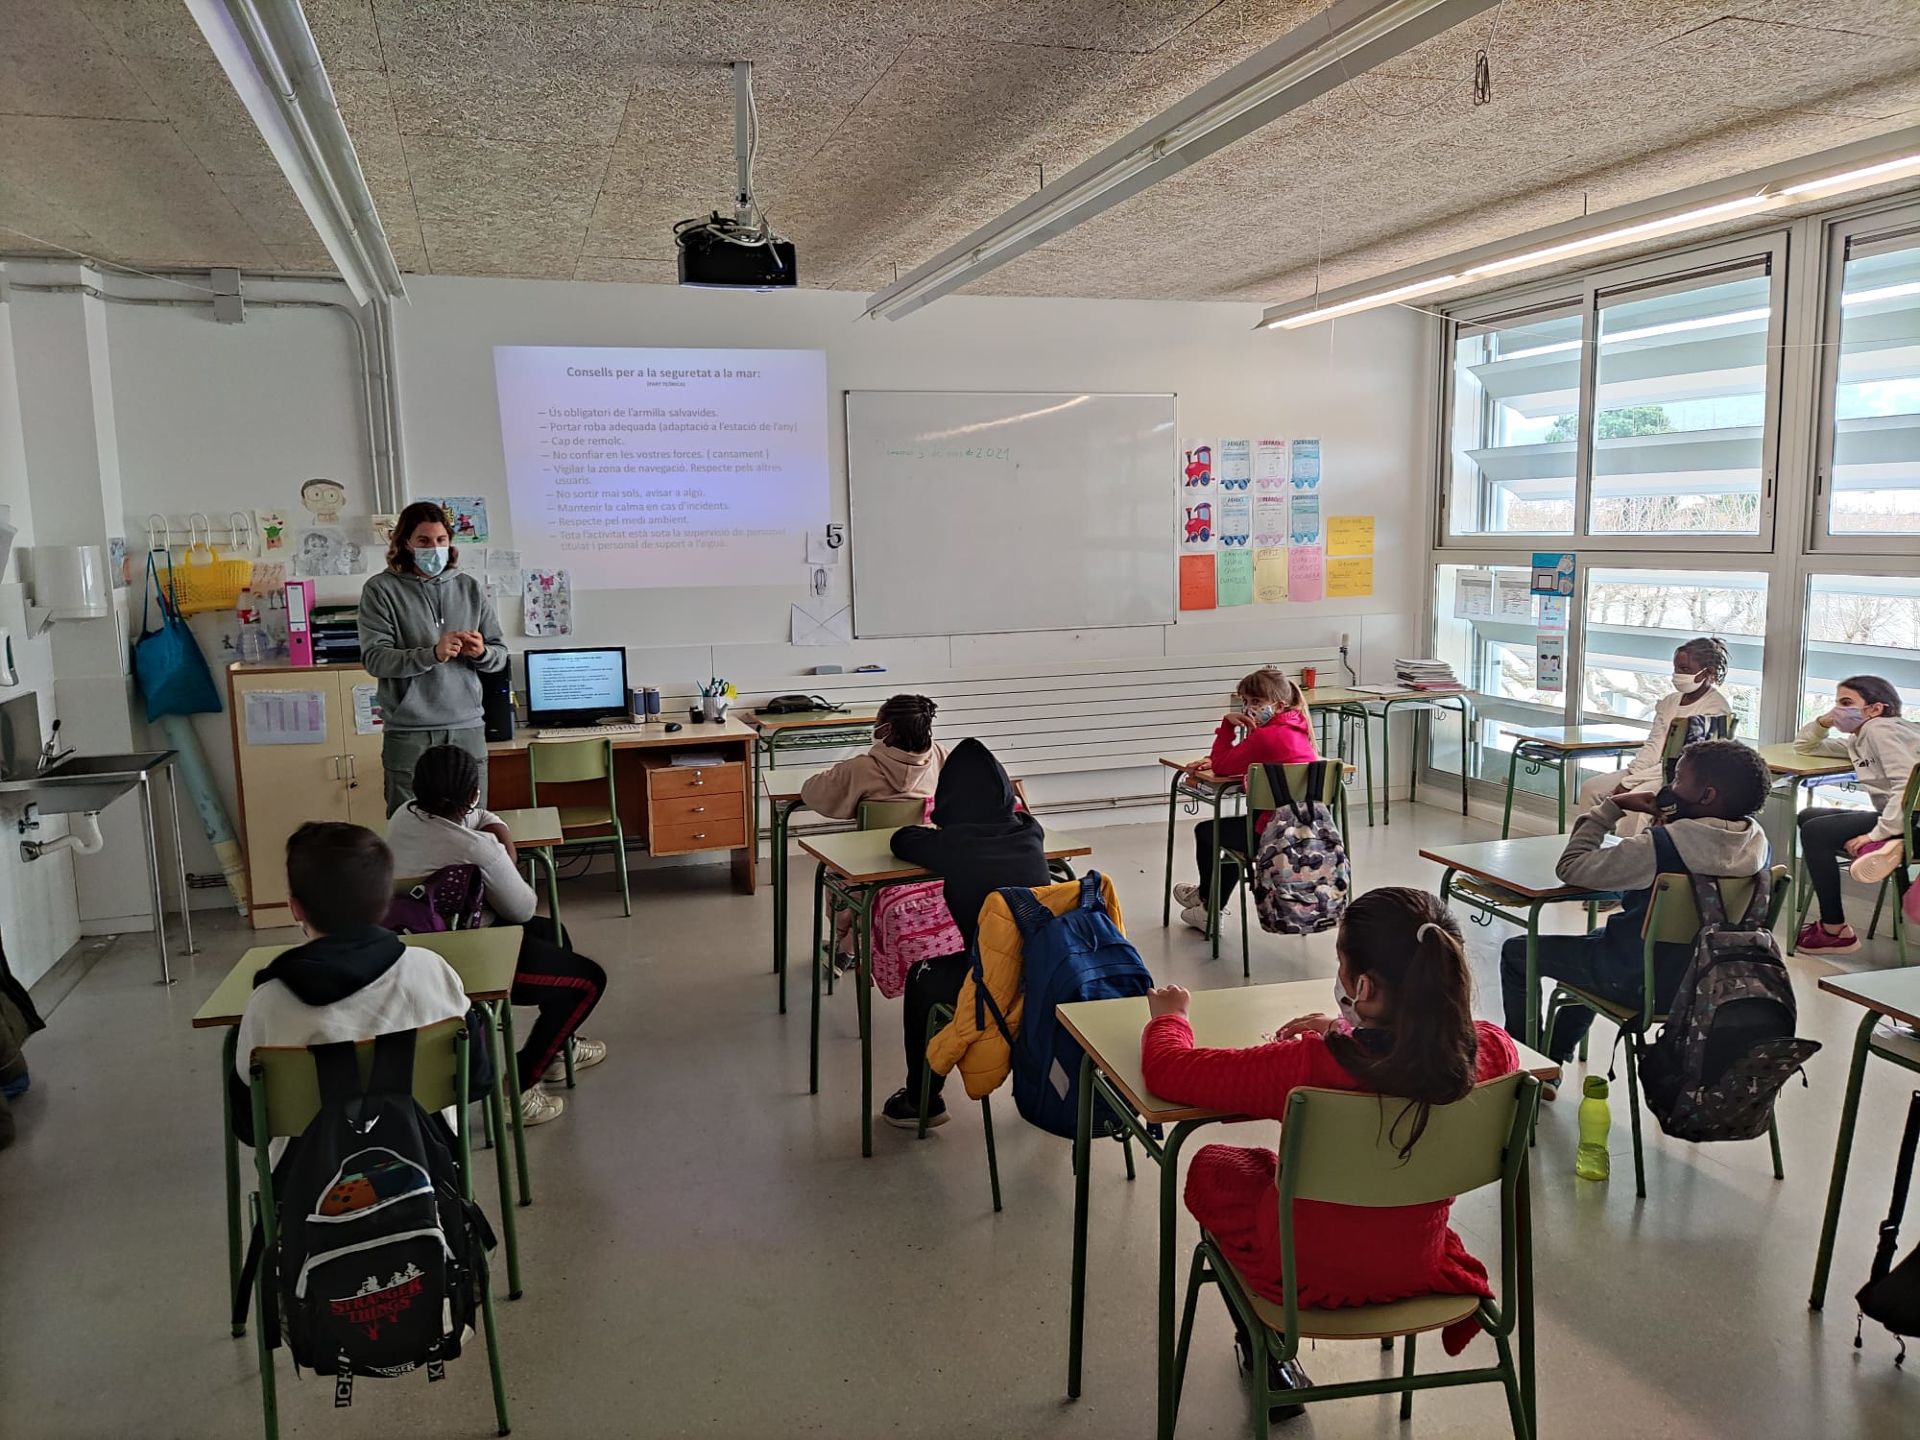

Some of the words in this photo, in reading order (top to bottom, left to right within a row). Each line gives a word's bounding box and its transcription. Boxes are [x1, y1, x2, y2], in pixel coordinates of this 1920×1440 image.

[566, 367, 613, 377] Consells
[616, 370, 634, 380] per
[637, 370, 644, 378] a
[647, 367, 657, 378] la
[660, 368, 712, 380] seguretat
[723, 368, 733, 379] la
[736, 370, 761, 379] mar:
[548, 405, 562, 417] Ús
[564, 407, 610, 419] obligatori
[613, 408, 626, 417] de
[628, 407, 666, 417] l'armilla
[669, 408, 718, 417] salvavides.
[550, 422, 581, 431] Portar
[583, 422, 606, 431] roba
[609, 422, 656, 433] adequada
[659, 421, 709, 433] (adaptació
[711, 423, 717, 431] a
[719, 421, 757, 431] l'estació
[759, 421, 771, 431] de
[551, 436, 570, 446] Cap
[572, 436, 585, 445] de
[552, 450, 568, 460] No
[569, 450, 603, 460] confiar
[621, 450, 634, 459] les
[637, 450, 671, 459] vostres
[553, 464, 585, 474] Vigilar
[587, 464, 596, 473] la
[598, 465, 621, 473] zona
[623, 463, 636, 472] de
[690, 463, 732, 474] Respecte
[735, 463, 753, 473] pels
[556, 490, 571, 498] No
[573, 490, 599, 498] sortir
[601, 489, 619, 498] mai
[645, 489, 672, 497] avisar
[557, 502, 602, 512] Mantenir
[604, 502, 613, 511] la
[615, 502, 645, 511] calma
[646, 503, 658, 511] en
[660, 503, 676, 511] cas
[558, 517, 602, 528] Respecte
[605, 516, 619, 526] pel
[621, 515, 645, 525] medi
[560, 530, 581, 539] Tota
[672, 528, 682, 537] la
[826, 523, 844, 549] 5
[641, 540, 654, 549] de
[329, 1278, 424, 1315] STRANGER
